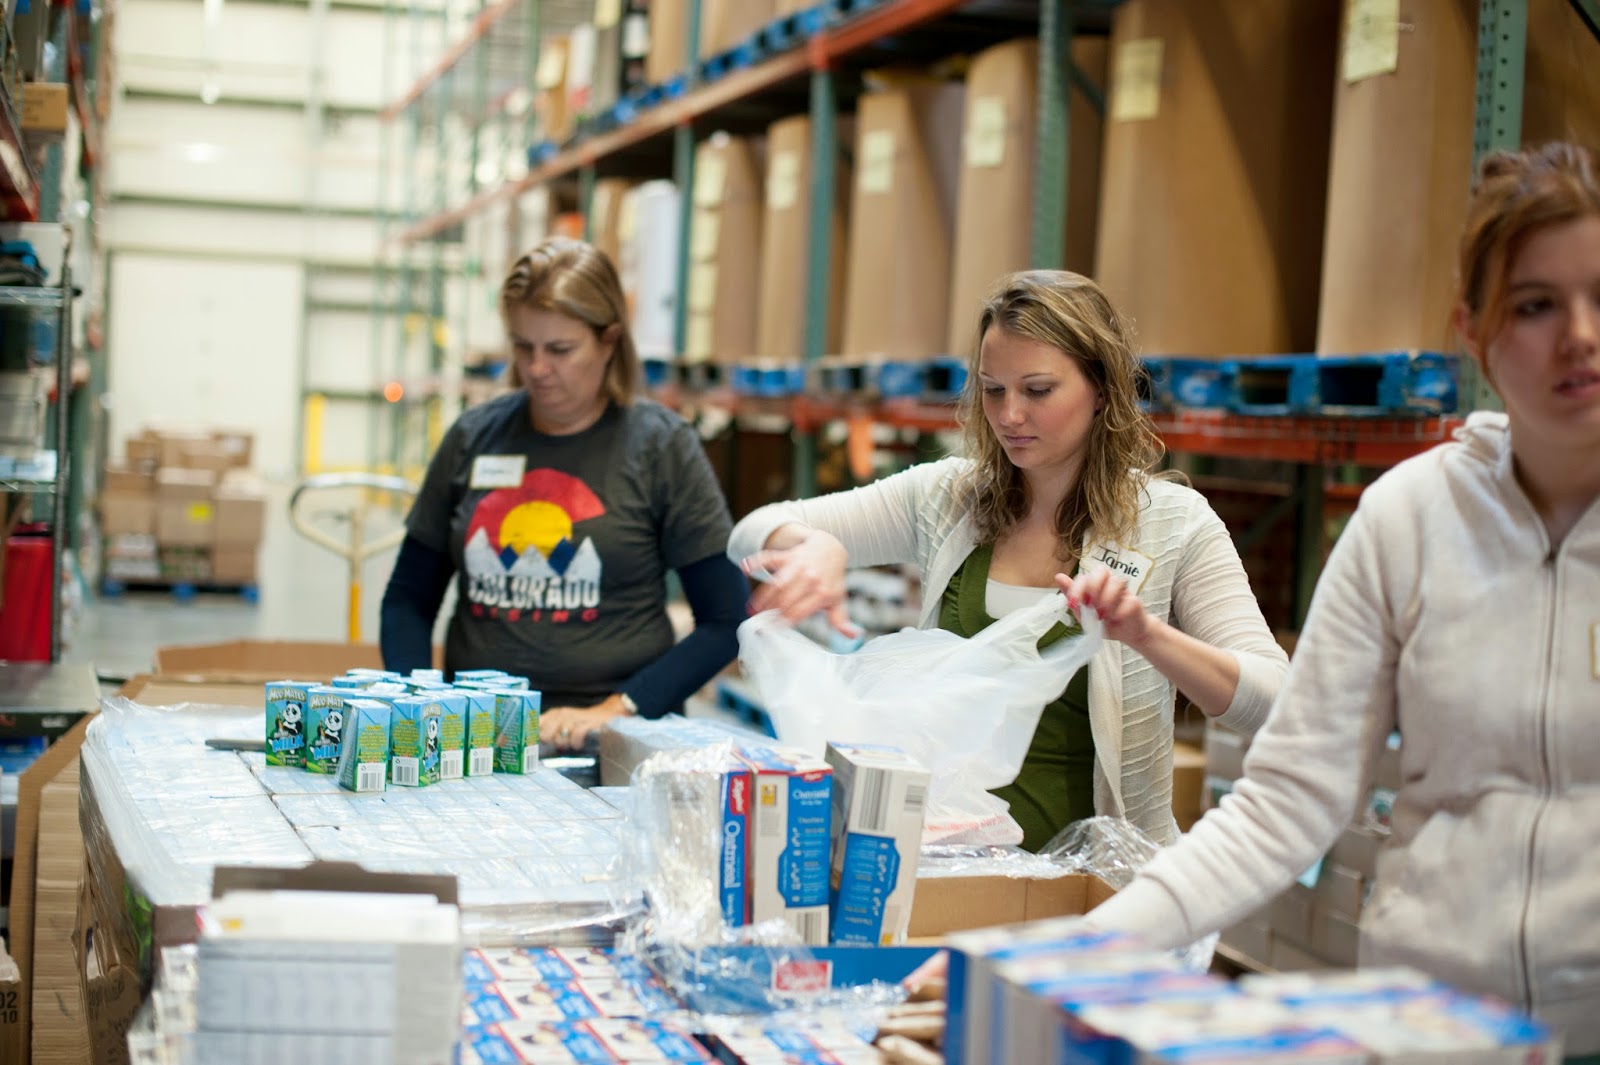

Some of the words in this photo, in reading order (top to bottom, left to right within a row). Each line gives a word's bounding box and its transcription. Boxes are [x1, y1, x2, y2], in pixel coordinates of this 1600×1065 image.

[1091, 545, 1140, 577] Jamie
[468, 572, 600, 609] COLORADO
[272, 734, 305, 752] MILK
[724, 820, 741, 889] Oatmeal
